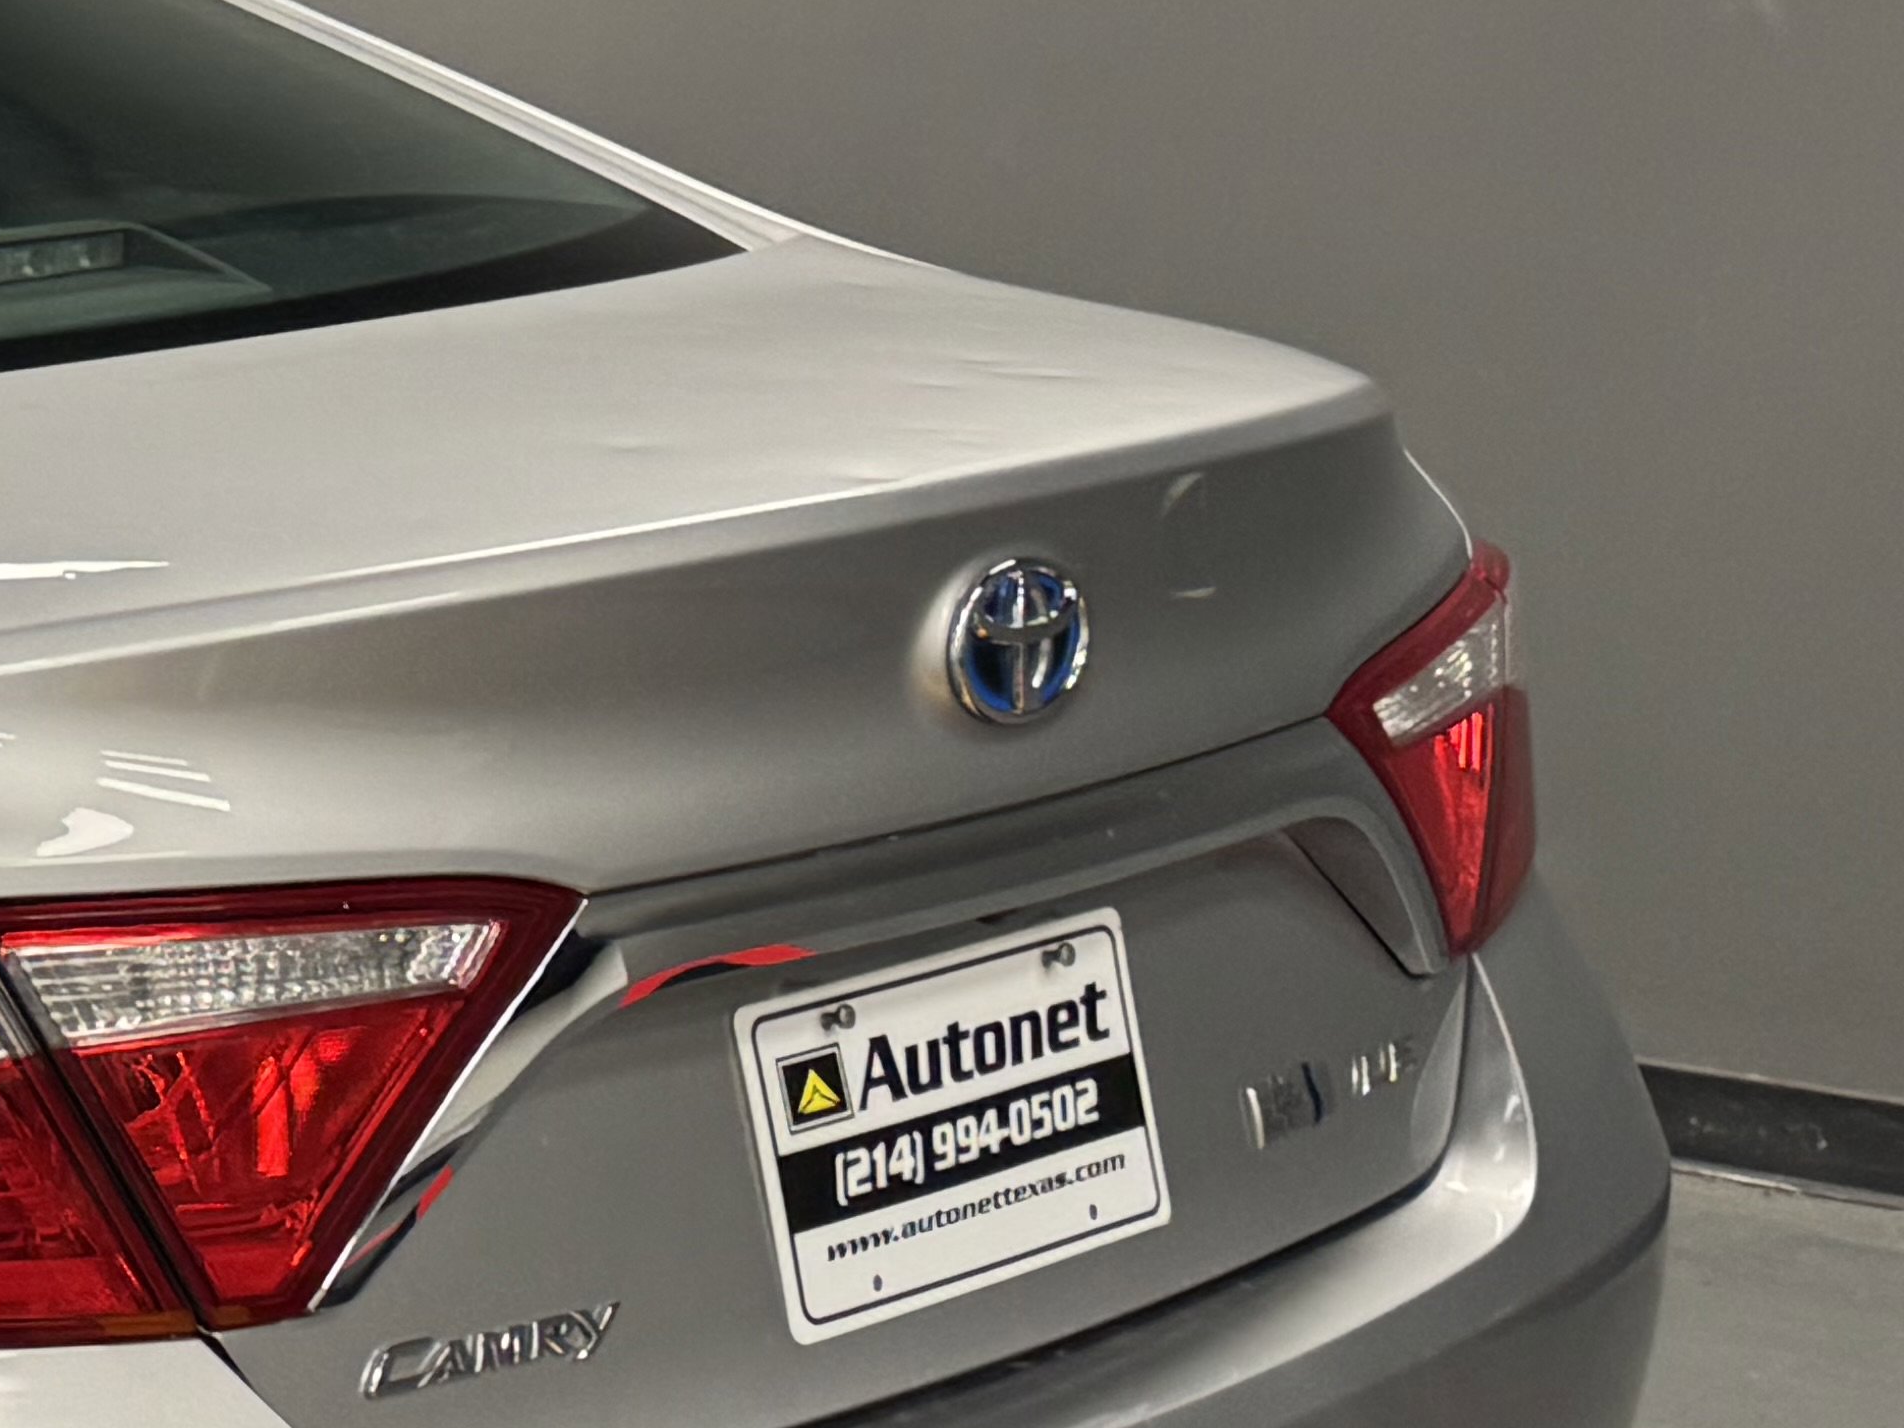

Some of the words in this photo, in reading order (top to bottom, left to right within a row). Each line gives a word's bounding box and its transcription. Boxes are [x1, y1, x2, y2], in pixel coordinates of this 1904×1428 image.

[859, 981, 1111, 1111] Autonet
[833, 1131, 925, 1207] (214)
[932, 1077, 1100, 1172] 994-0502
[826, 1152, 1126, 1263] www.autonettexas.com
[358, 1300, 622, 1400] CAMRY
